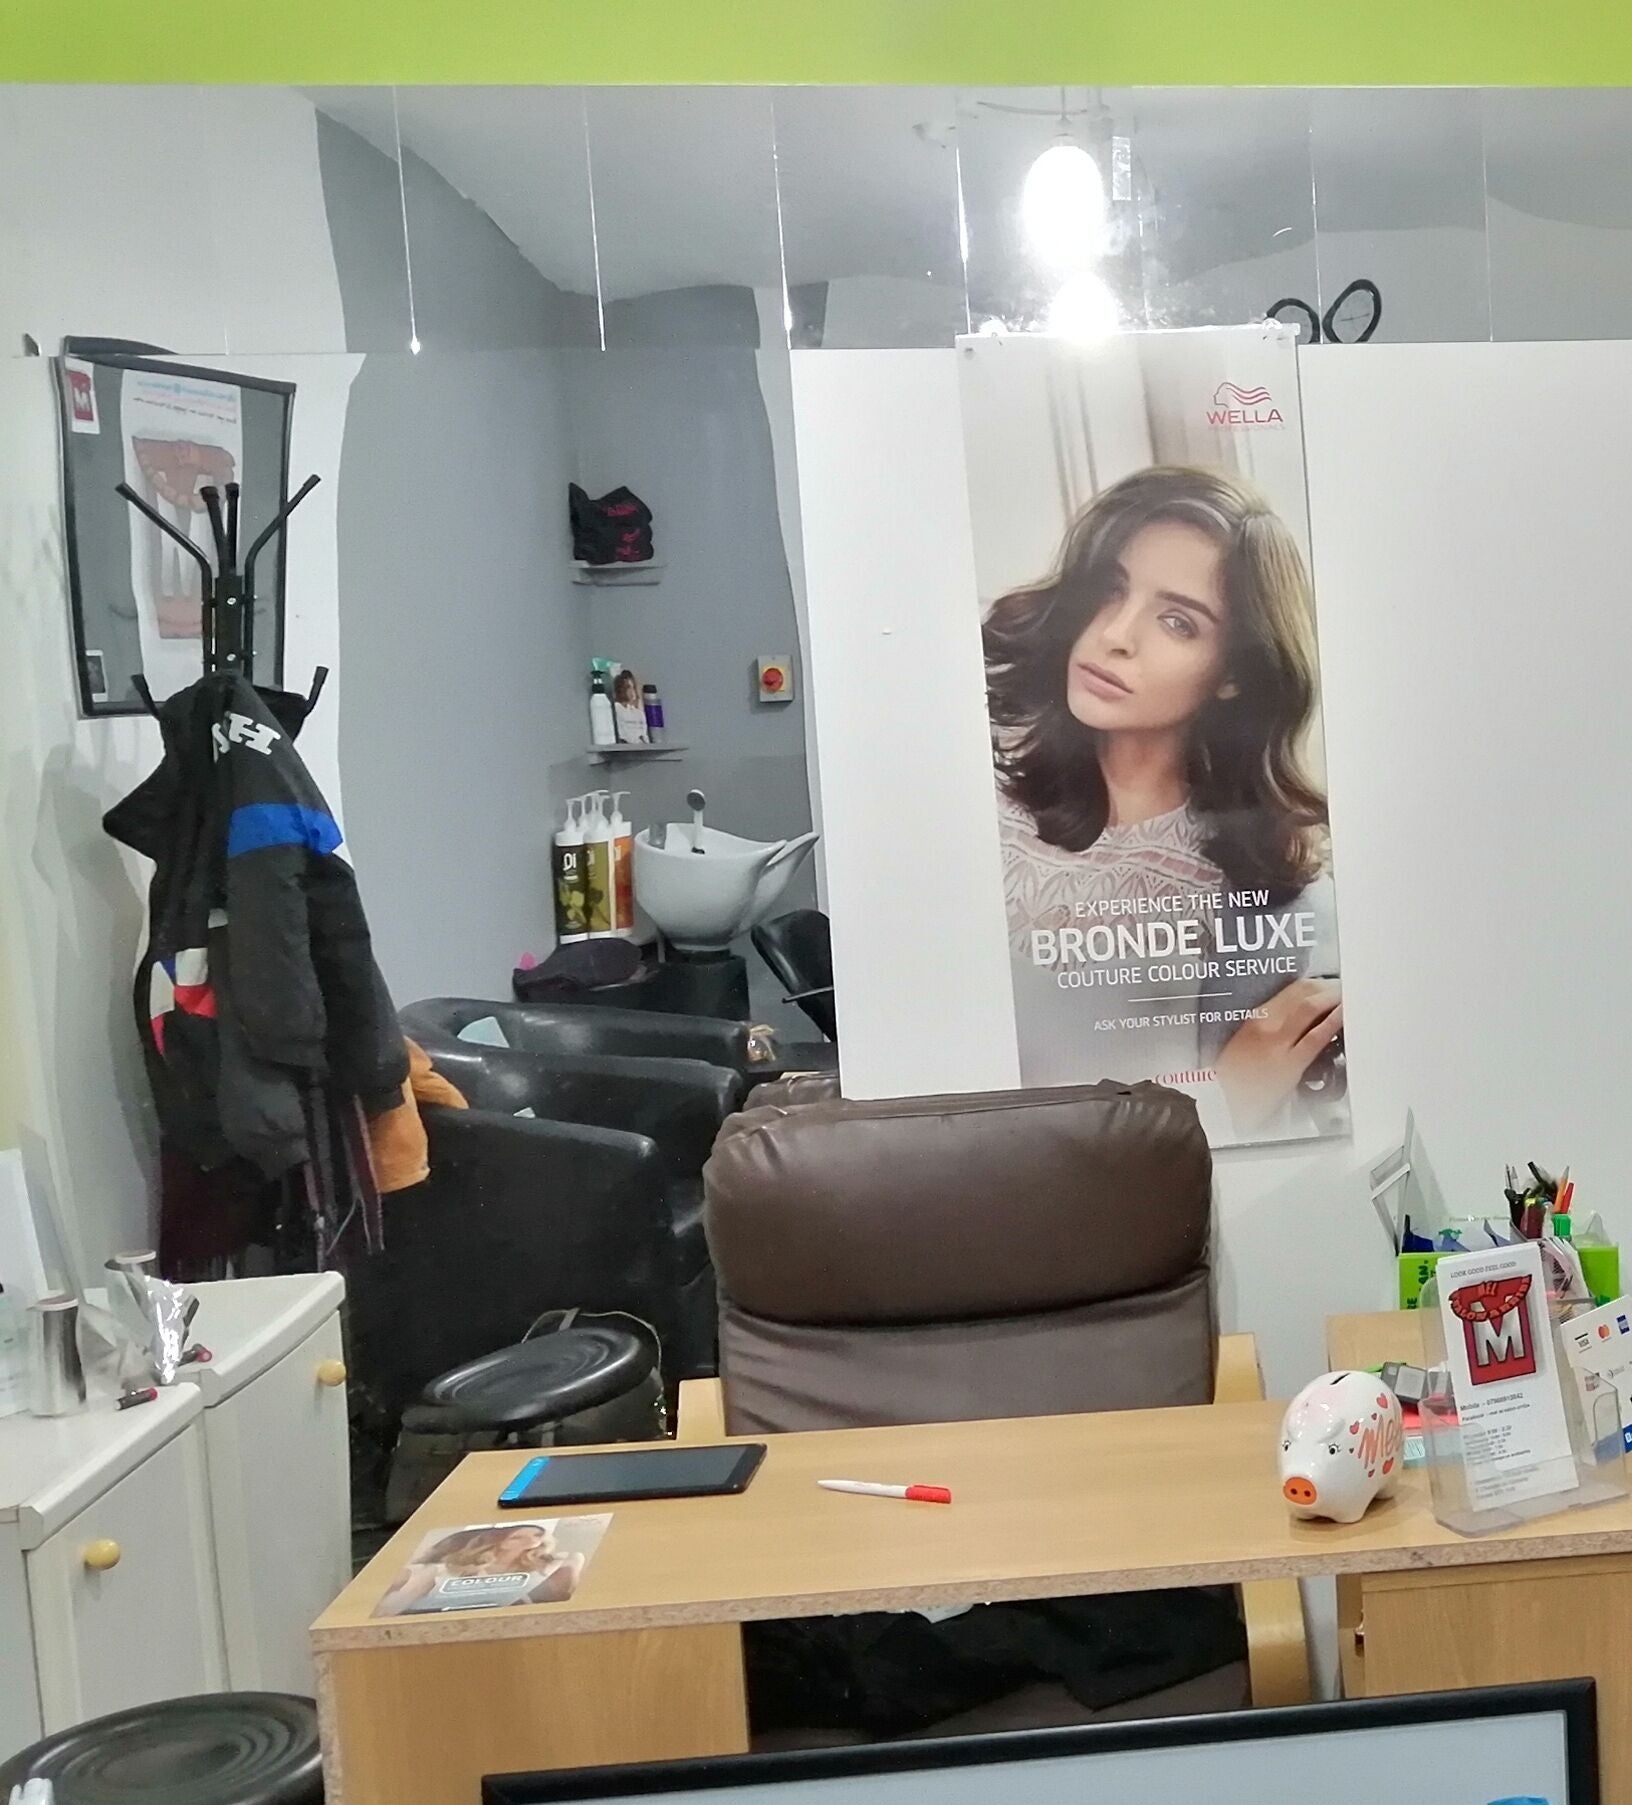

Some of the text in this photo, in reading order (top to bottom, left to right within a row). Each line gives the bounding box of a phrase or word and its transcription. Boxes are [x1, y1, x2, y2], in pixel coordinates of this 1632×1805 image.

[1206, 408, 1284, 425] WELLA
[1075, 889, 1269, 918] EXPERIENCE THE NEW
[1031, 911, 1318, 966] BRONDE LUXE
[1057, 956, 1297, 989] COUTURE COLOUR SERVICE
[1094, 1008, 1269, 1031] ASK YOUR STYLIST FOR DETAILS
[1155, 1068, 1217, 1085] couture
[1472, 1302, 1525, 1367] M
[451, 1576, 523, 1586] COLOUR
